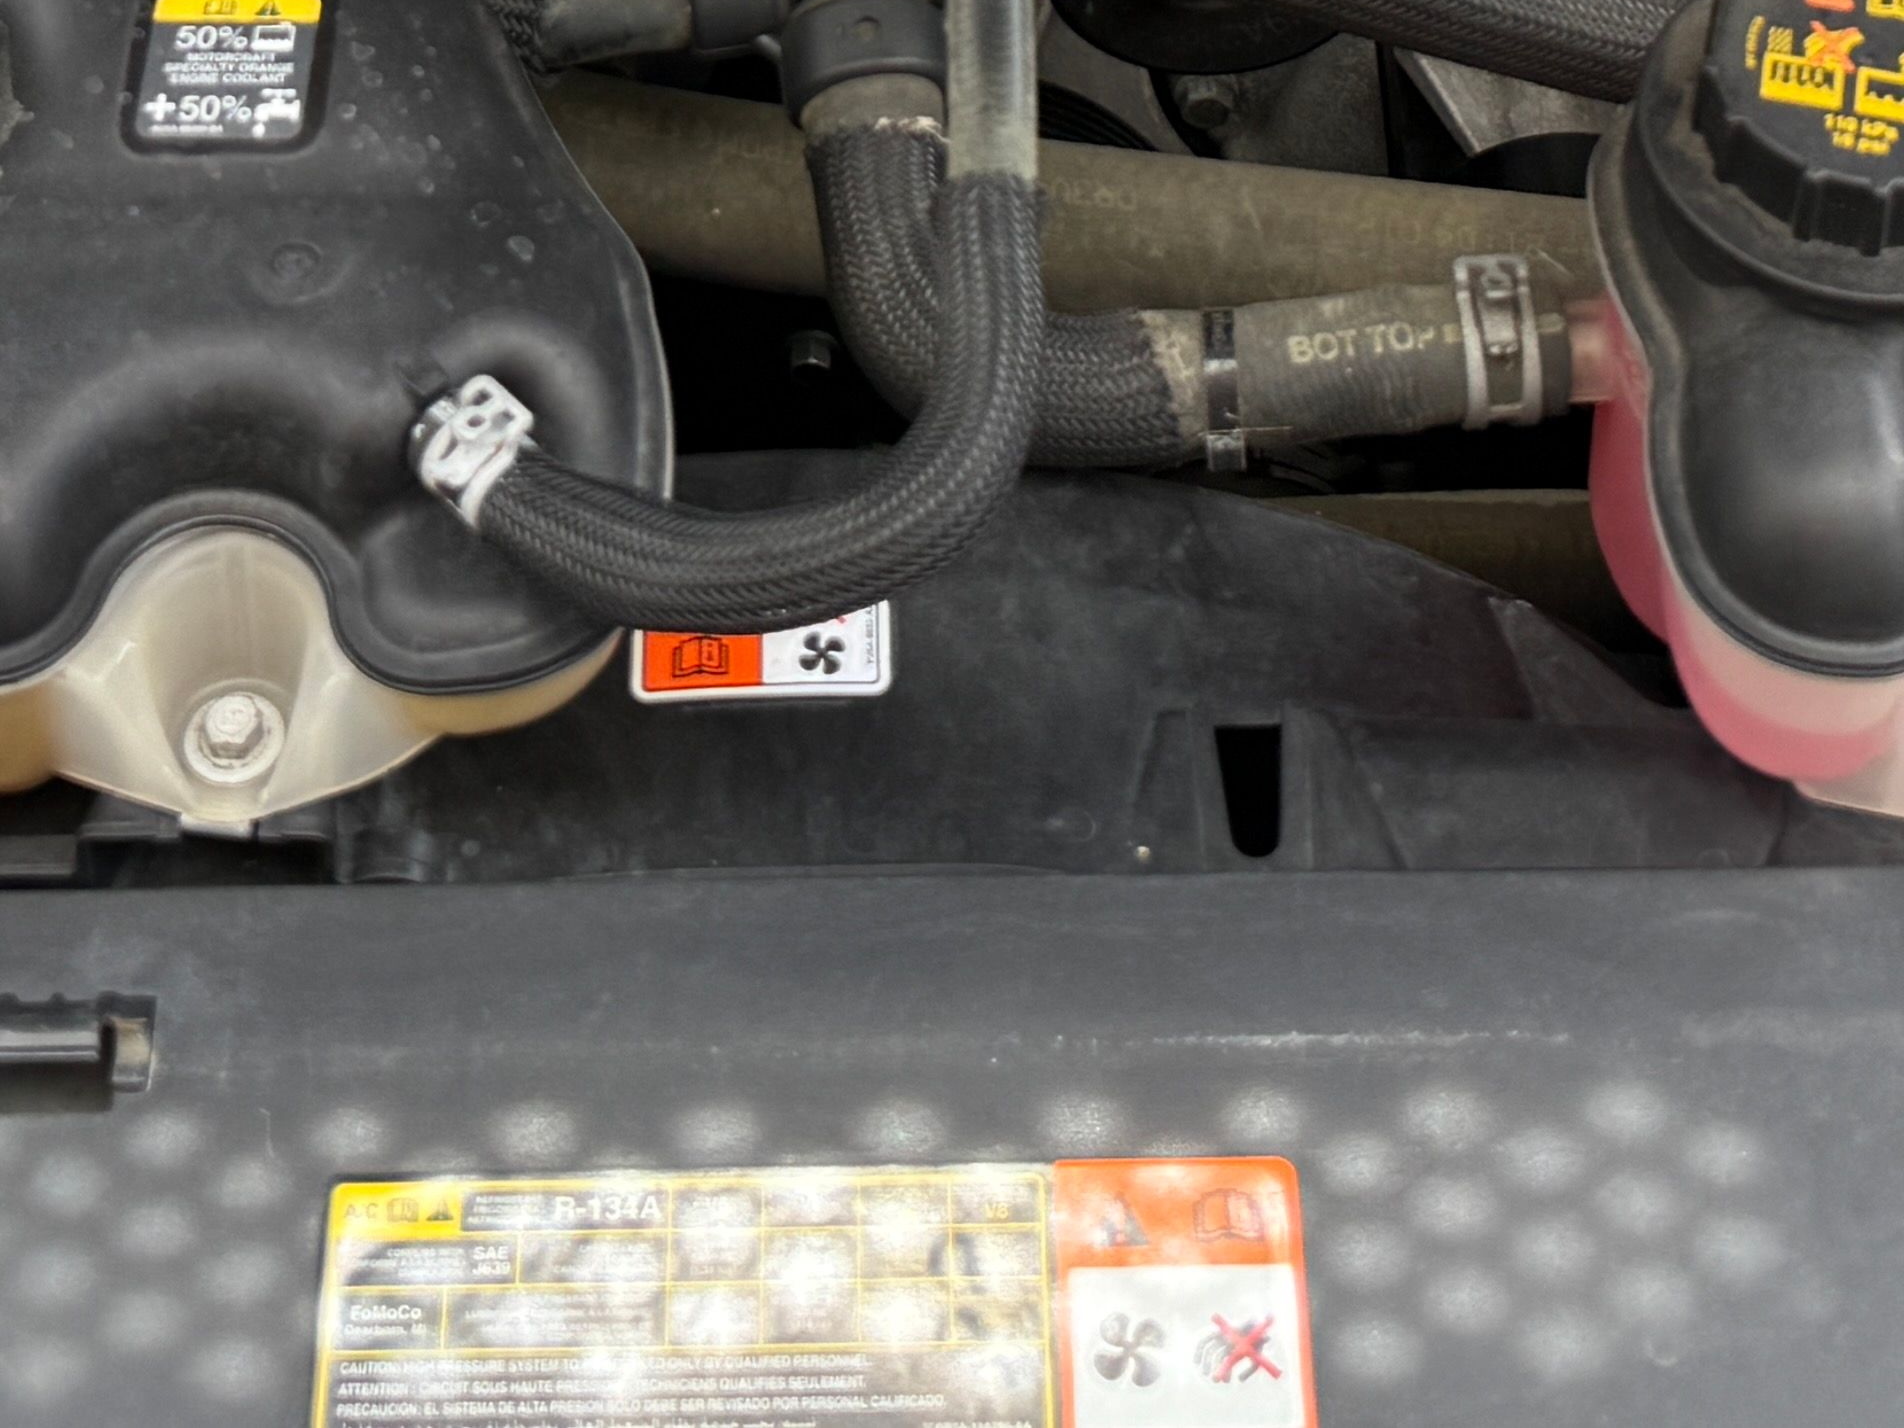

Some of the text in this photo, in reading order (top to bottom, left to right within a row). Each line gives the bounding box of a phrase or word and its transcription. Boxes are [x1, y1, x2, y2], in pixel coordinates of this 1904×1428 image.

[174, 25, 249, 51] 50%
[185, 51, 276, 63] MOTORCRAFT
[162, 61, 296, 74] SPECIALTY ORANGE
[221, 71, 288, 84] COOLANT
[1287, 327, 1358, 365] BOT
[552, 1195, 662, 1222] R-134A
[472, 1245, 510, 1261] SAE
[436, 1358, 505, 1373] PRESSURE
[724, 1354, 791, 1368] QUALIFIED
[471, 1378, 508, 1394] SOUS
[509, 1377, 553, 1393] HAUTE
[441, 1399, 497, 1416] SISTEMA
[498, 1399, 517, 1415] DE
[518, 1398, 548, 1414] ALTA
[710, 1395, 770, 1412] REVISADO
[772, 1394, 799, 1411] POR
[801, 1393, 868, 1411] PERSONAL
